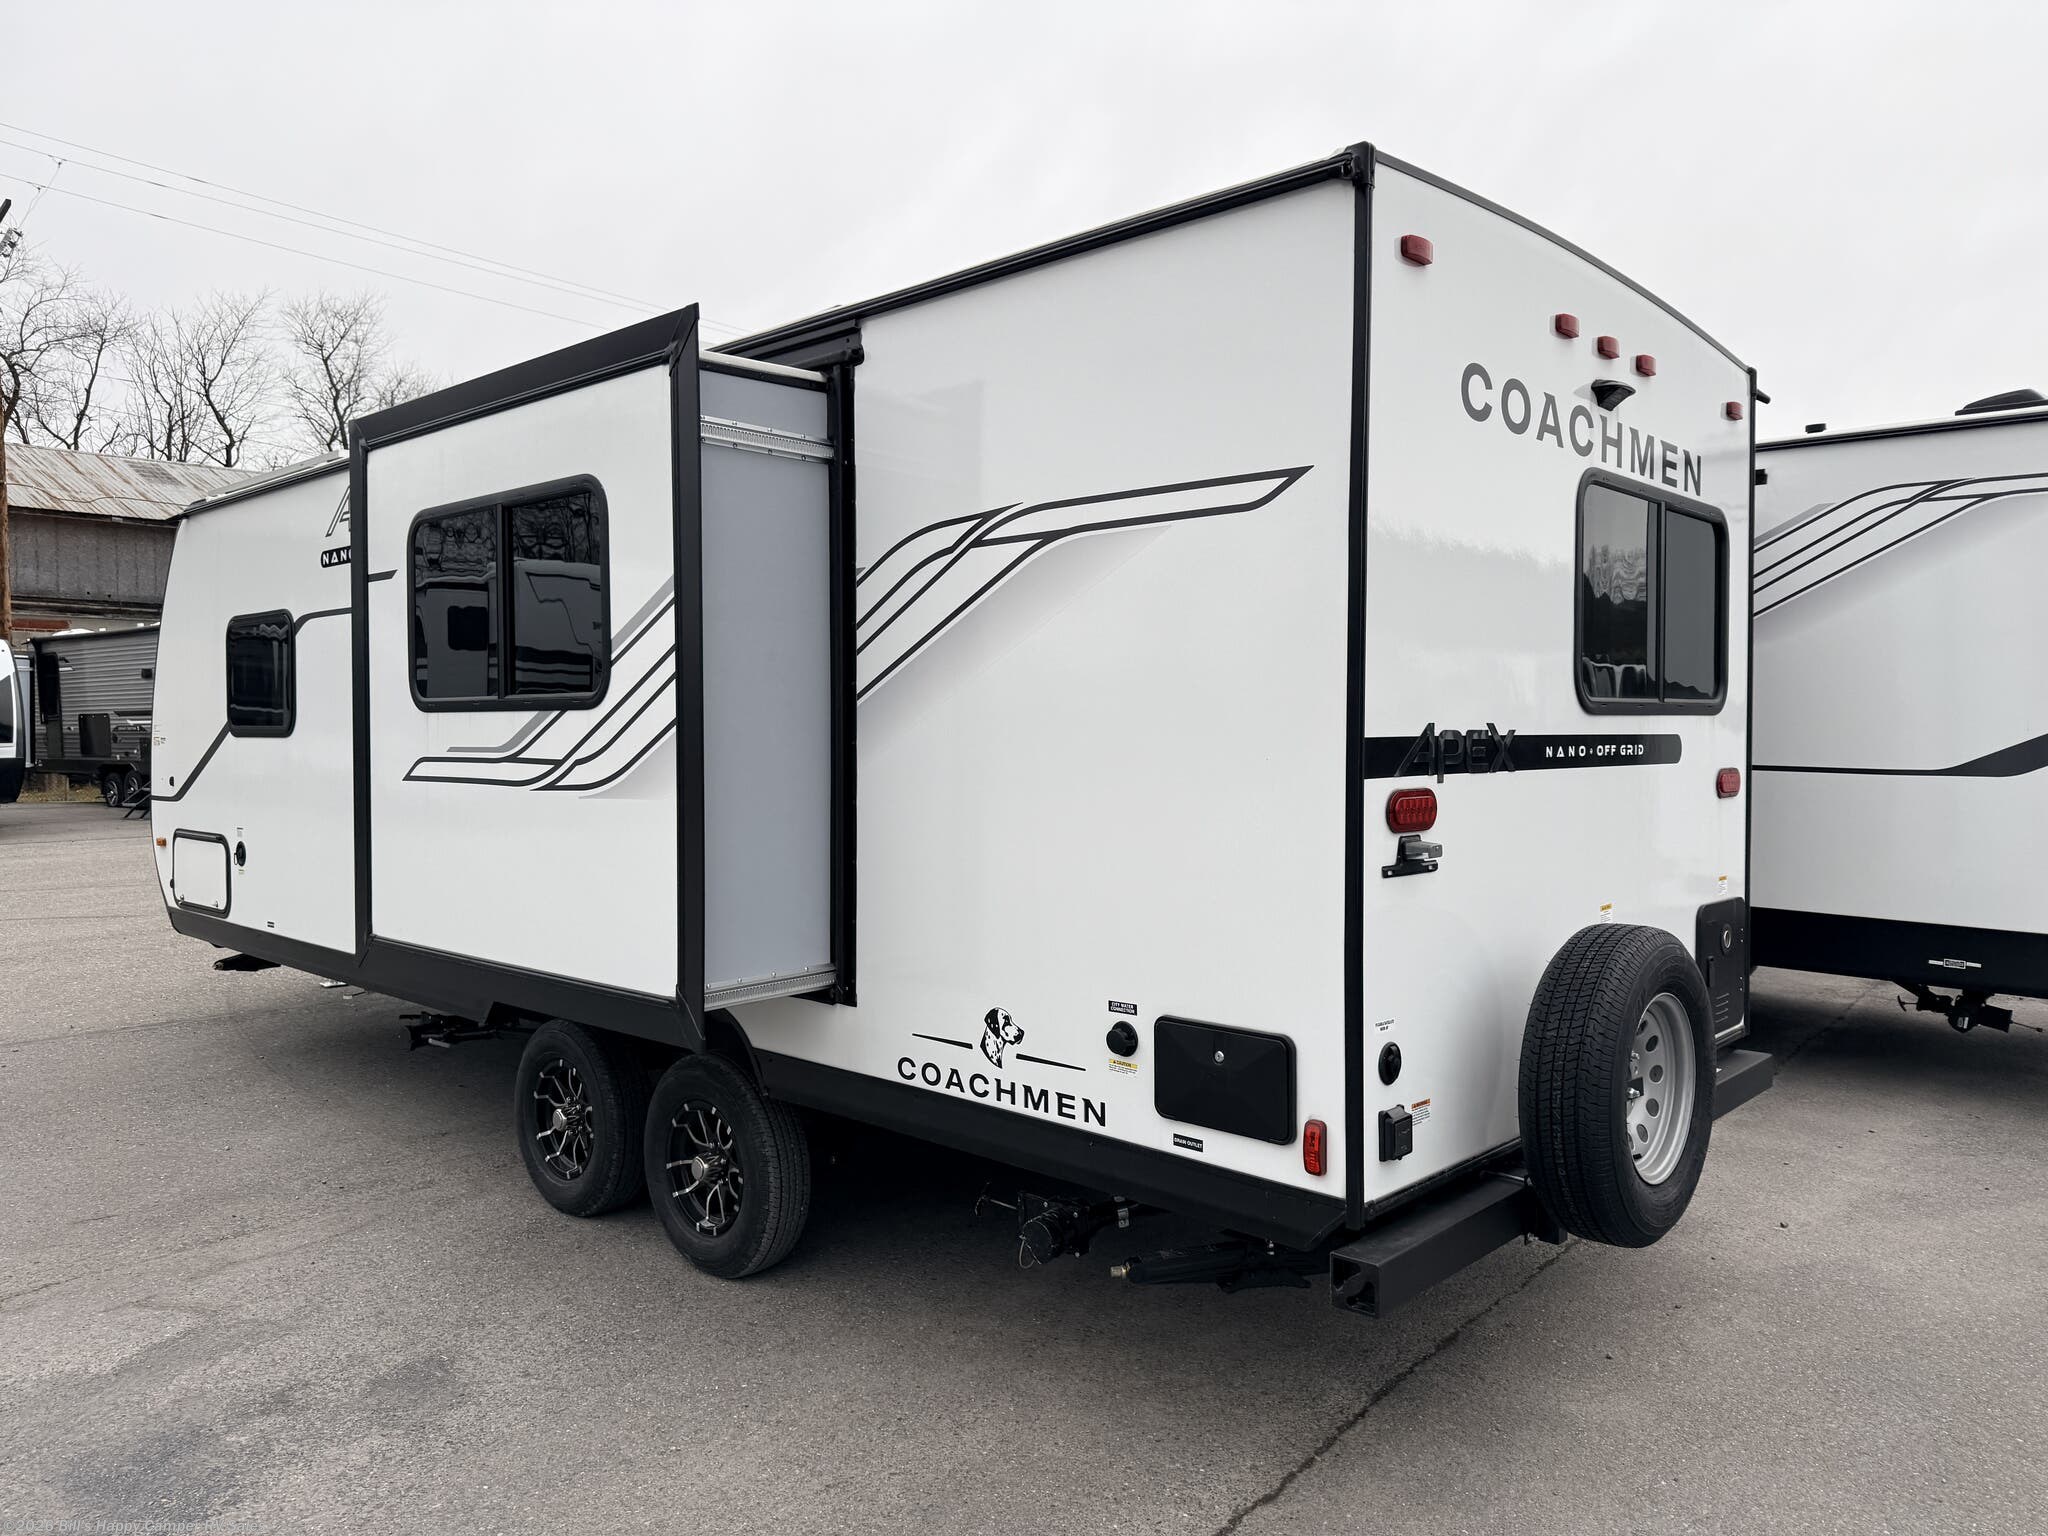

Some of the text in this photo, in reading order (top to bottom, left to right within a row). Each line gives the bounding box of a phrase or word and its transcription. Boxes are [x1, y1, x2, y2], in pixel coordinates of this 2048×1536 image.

[1461, 362, 1701, 496] COACHMEN
[1394, 722, 1516, 783] APEX
[1545, 744, 1644, 758] NANO OFF GRID
[897, 1056, 1106, 1127] COACHMEN
